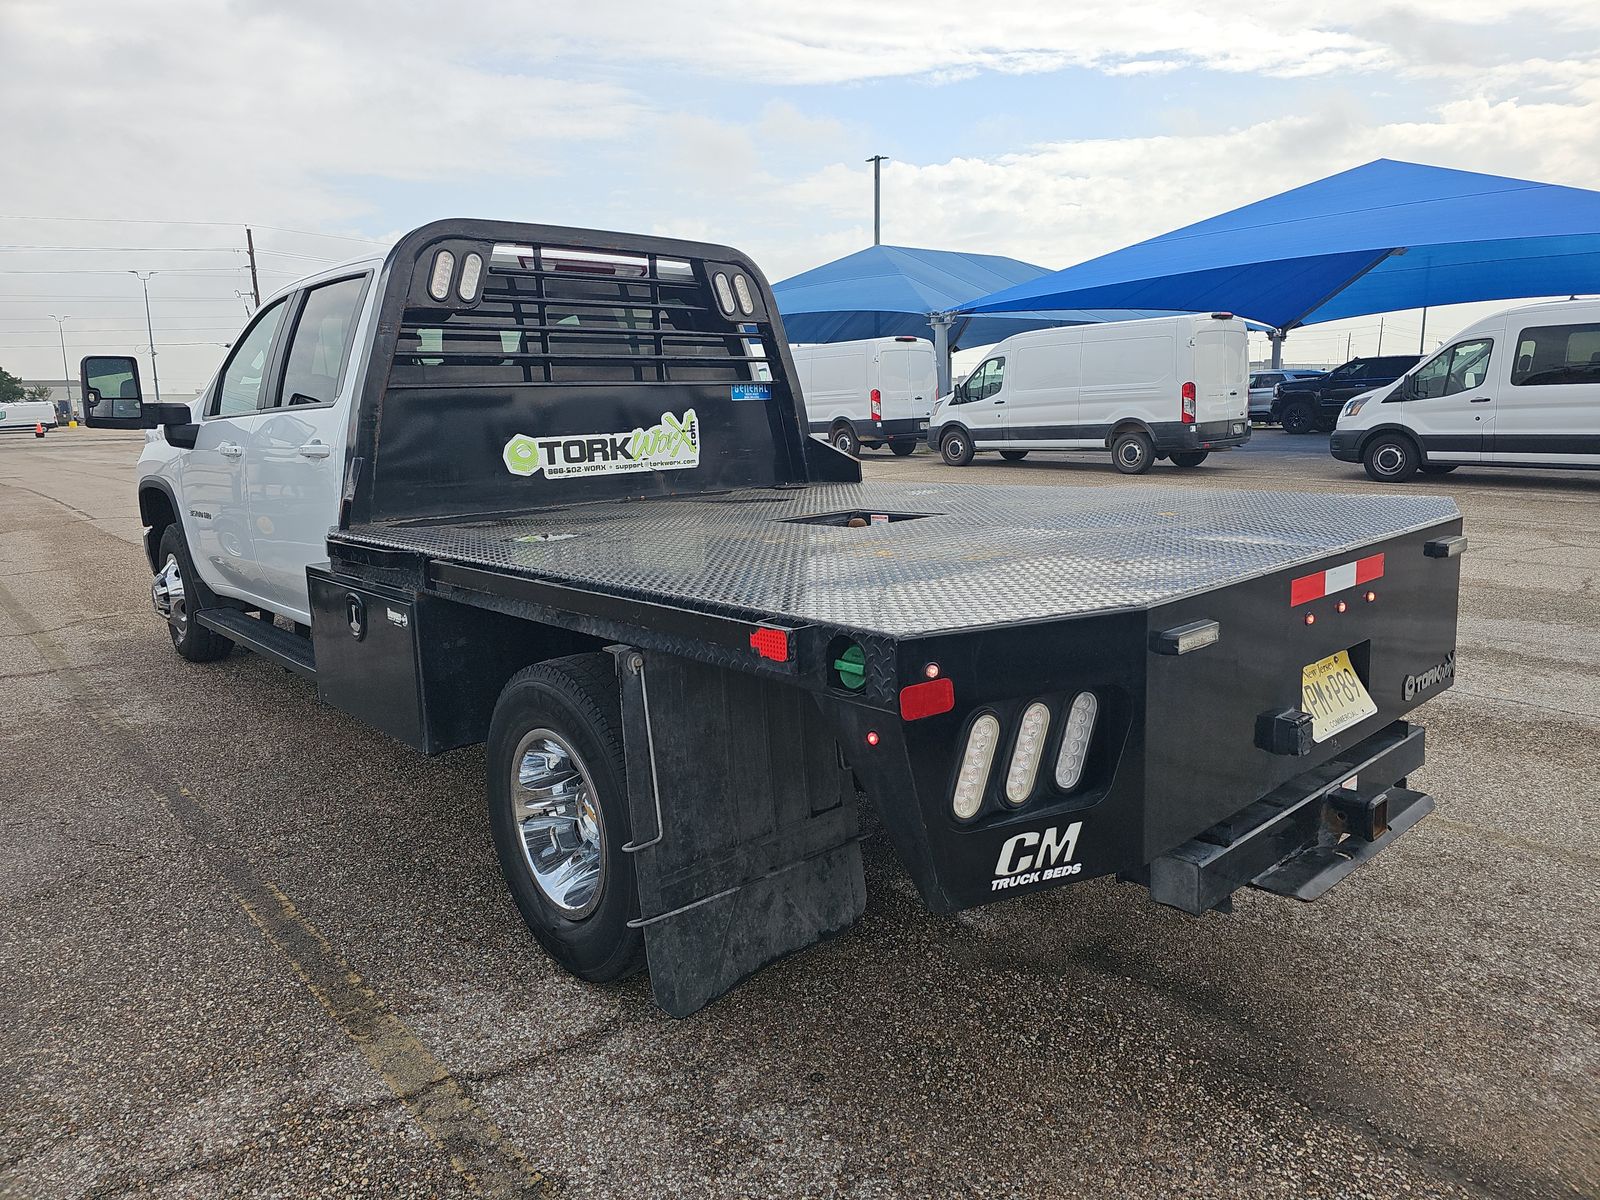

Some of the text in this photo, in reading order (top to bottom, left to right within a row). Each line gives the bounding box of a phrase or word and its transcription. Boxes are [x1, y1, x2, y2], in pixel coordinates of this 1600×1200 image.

[615, 459, 697, 470] supporttorkworx.com
[1317, 661, 1334, 677] Jersey
[1329, 712, 1359, 728] COMMERCIAL
[994, 821, 1083, 876] CM
[991, 863, 1083, 891] TRUCK BEDS
